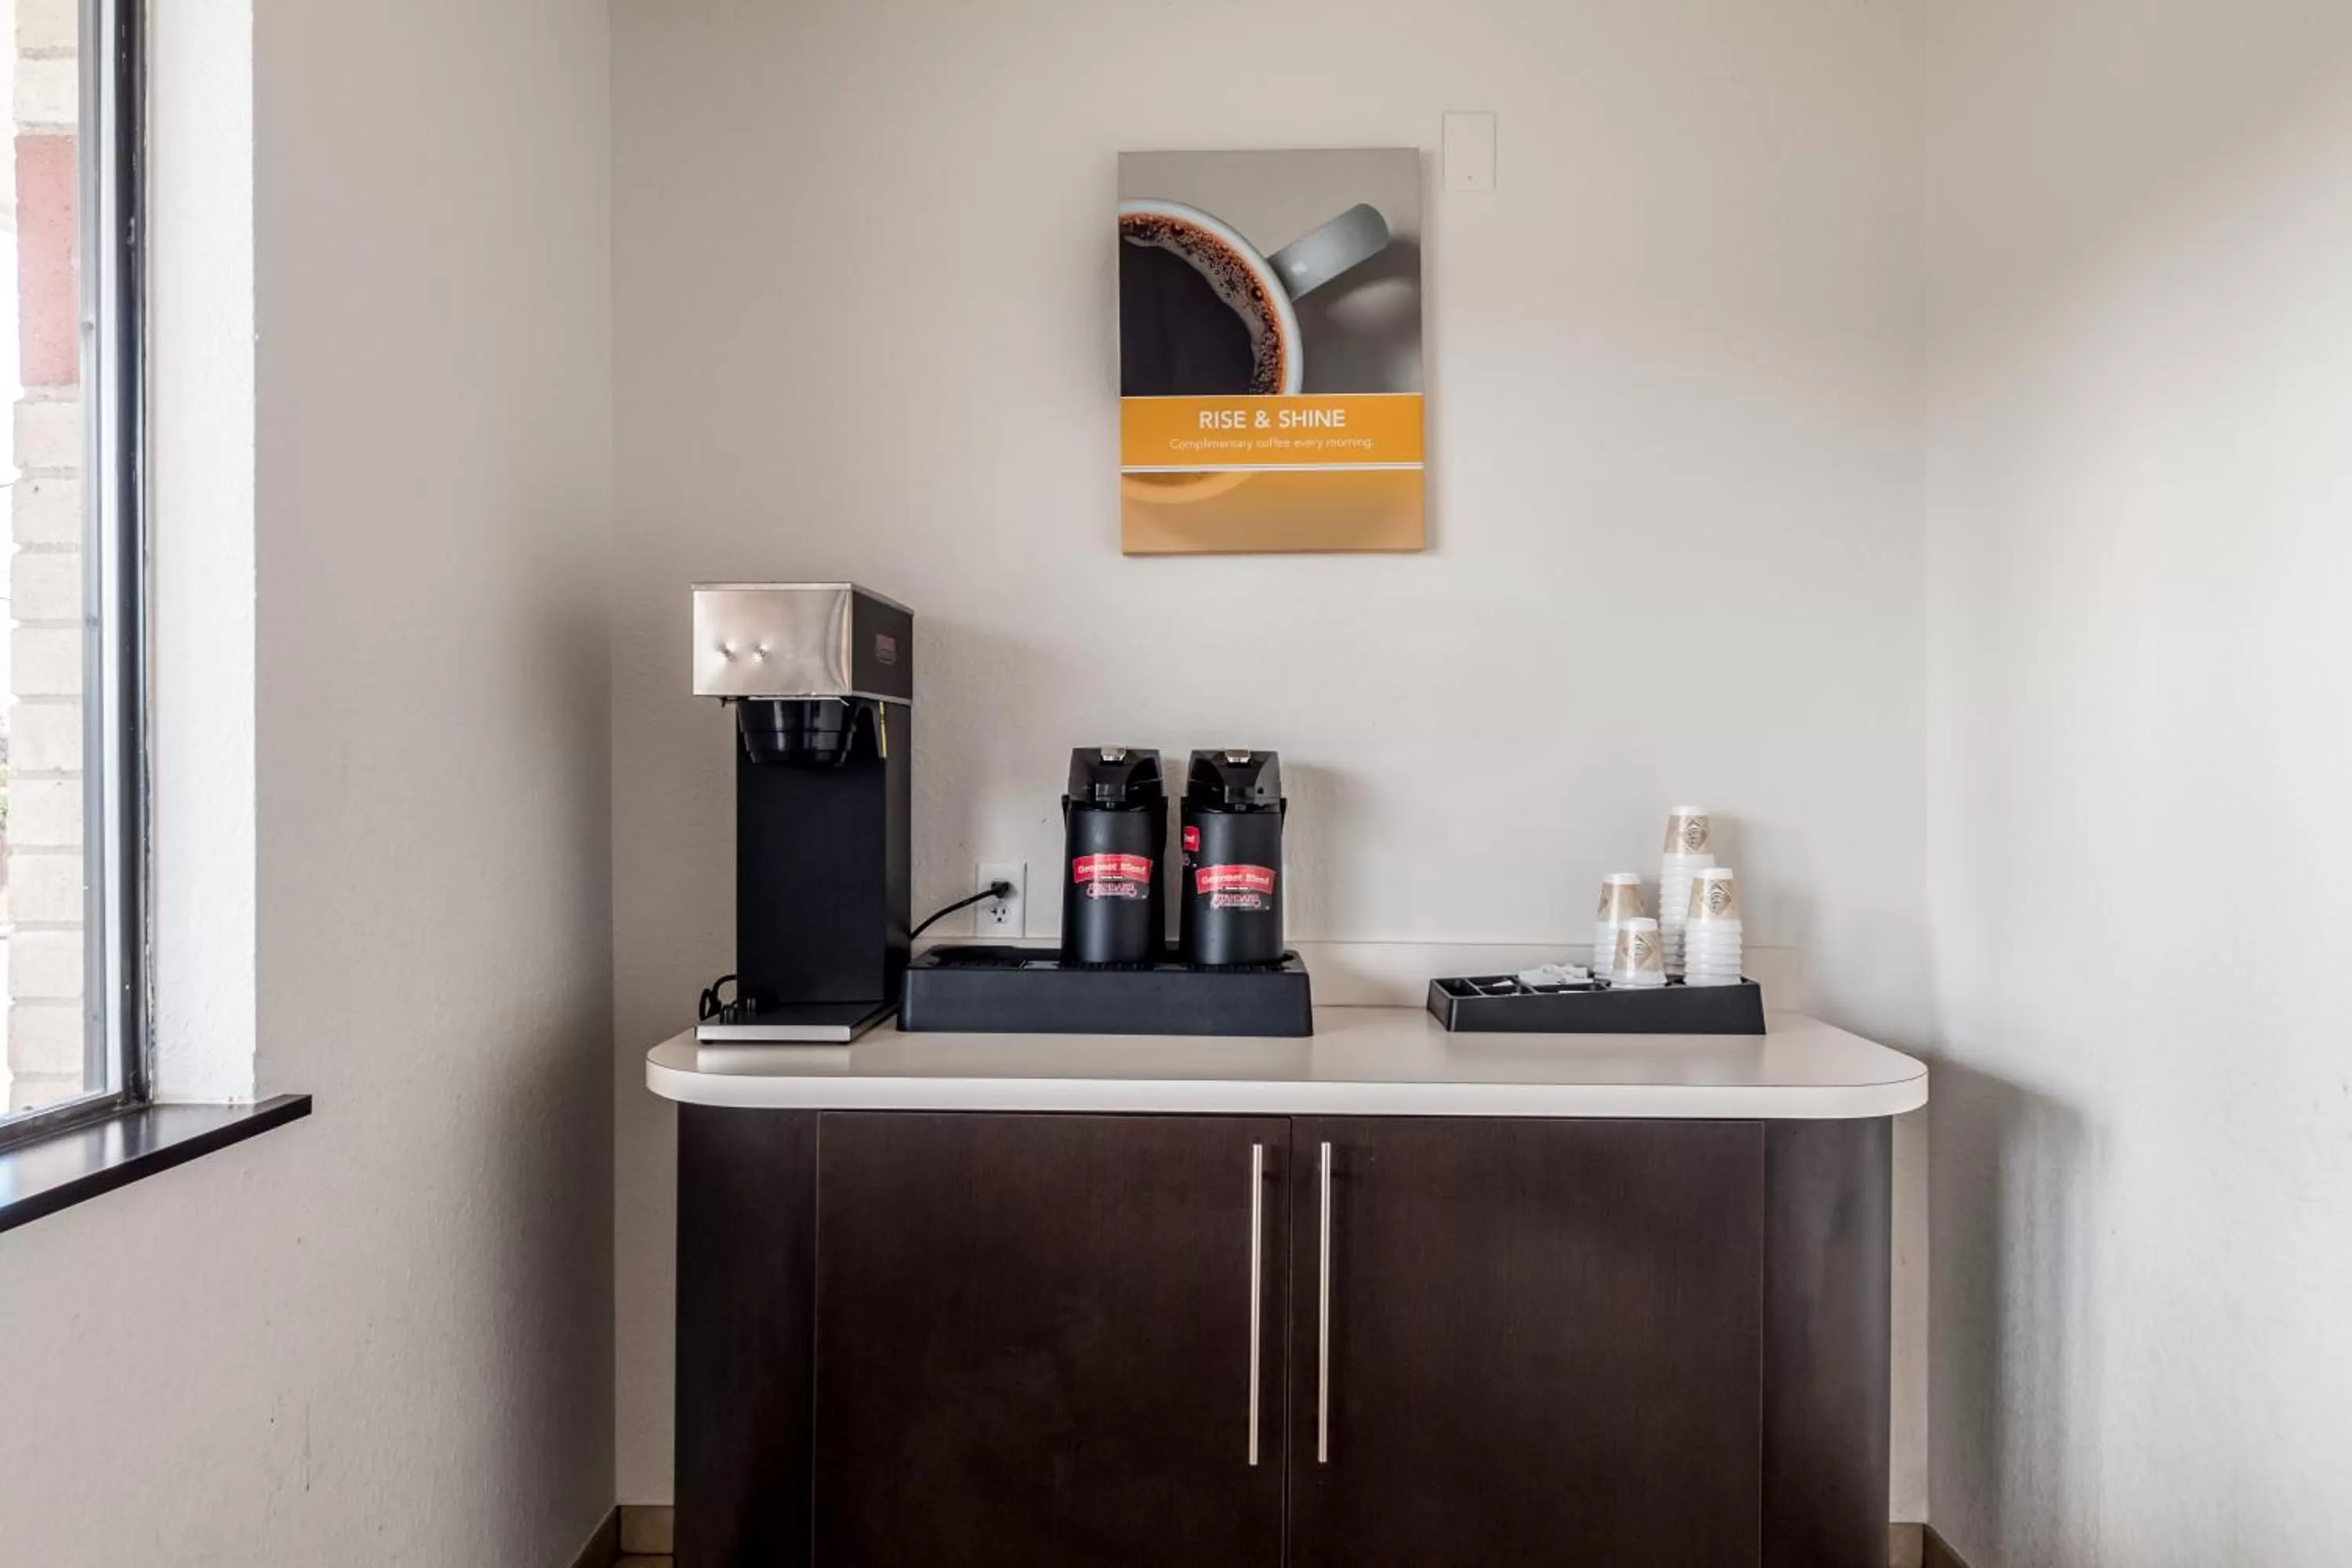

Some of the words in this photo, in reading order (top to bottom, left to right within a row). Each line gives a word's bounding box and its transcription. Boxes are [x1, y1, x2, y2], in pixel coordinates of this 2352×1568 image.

[1199, 410, 1247, 429] RISE
[1254, 410, 1271, 429] &
[1279, 408, 1346, 428] SHINE
[1169, 437, 1254, 452] Complimentary
[1256, 437, 1290, 448] coffee
[1294, 438, 1324, 451] every
